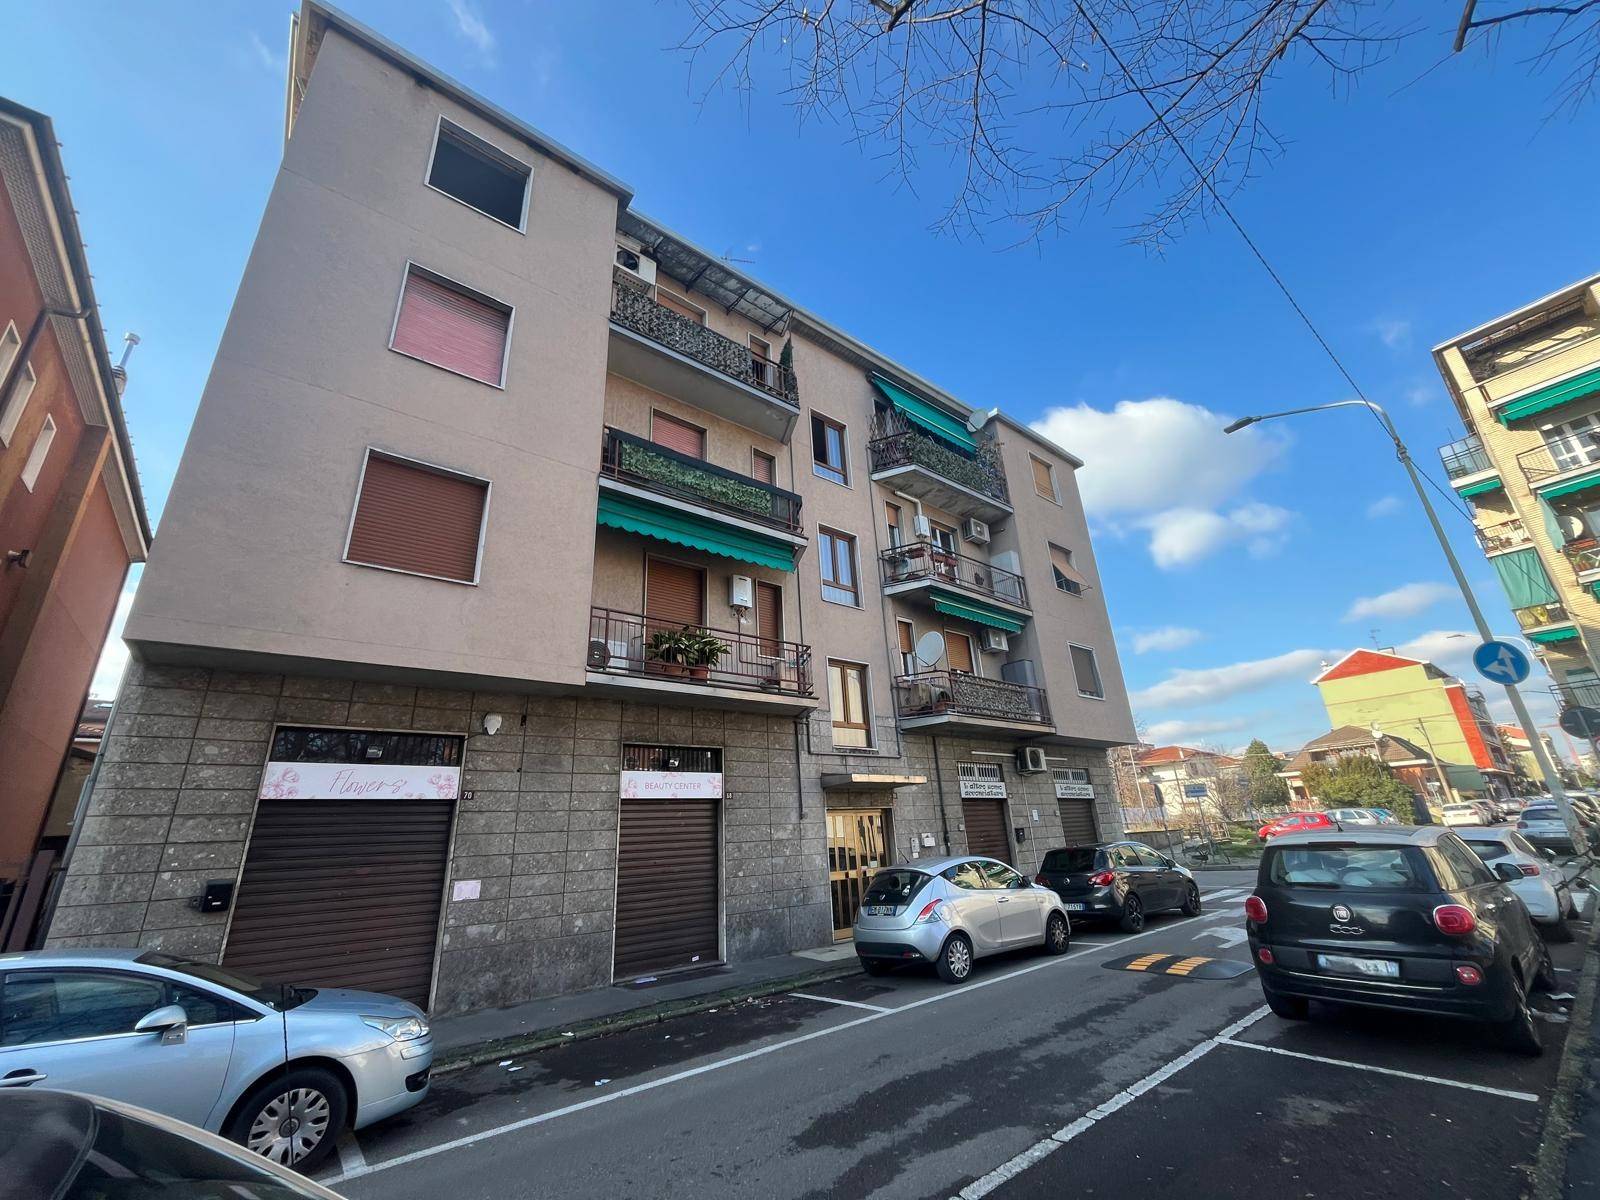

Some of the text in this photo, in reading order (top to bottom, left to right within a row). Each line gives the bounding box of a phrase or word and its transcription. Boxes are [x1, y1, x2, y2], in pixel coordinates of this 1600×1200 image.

[329, 768, 407, 795] Flowers
[644, 782, 701, 790] BEAUTY CENTER
[463, 791, 473, 799] 70
